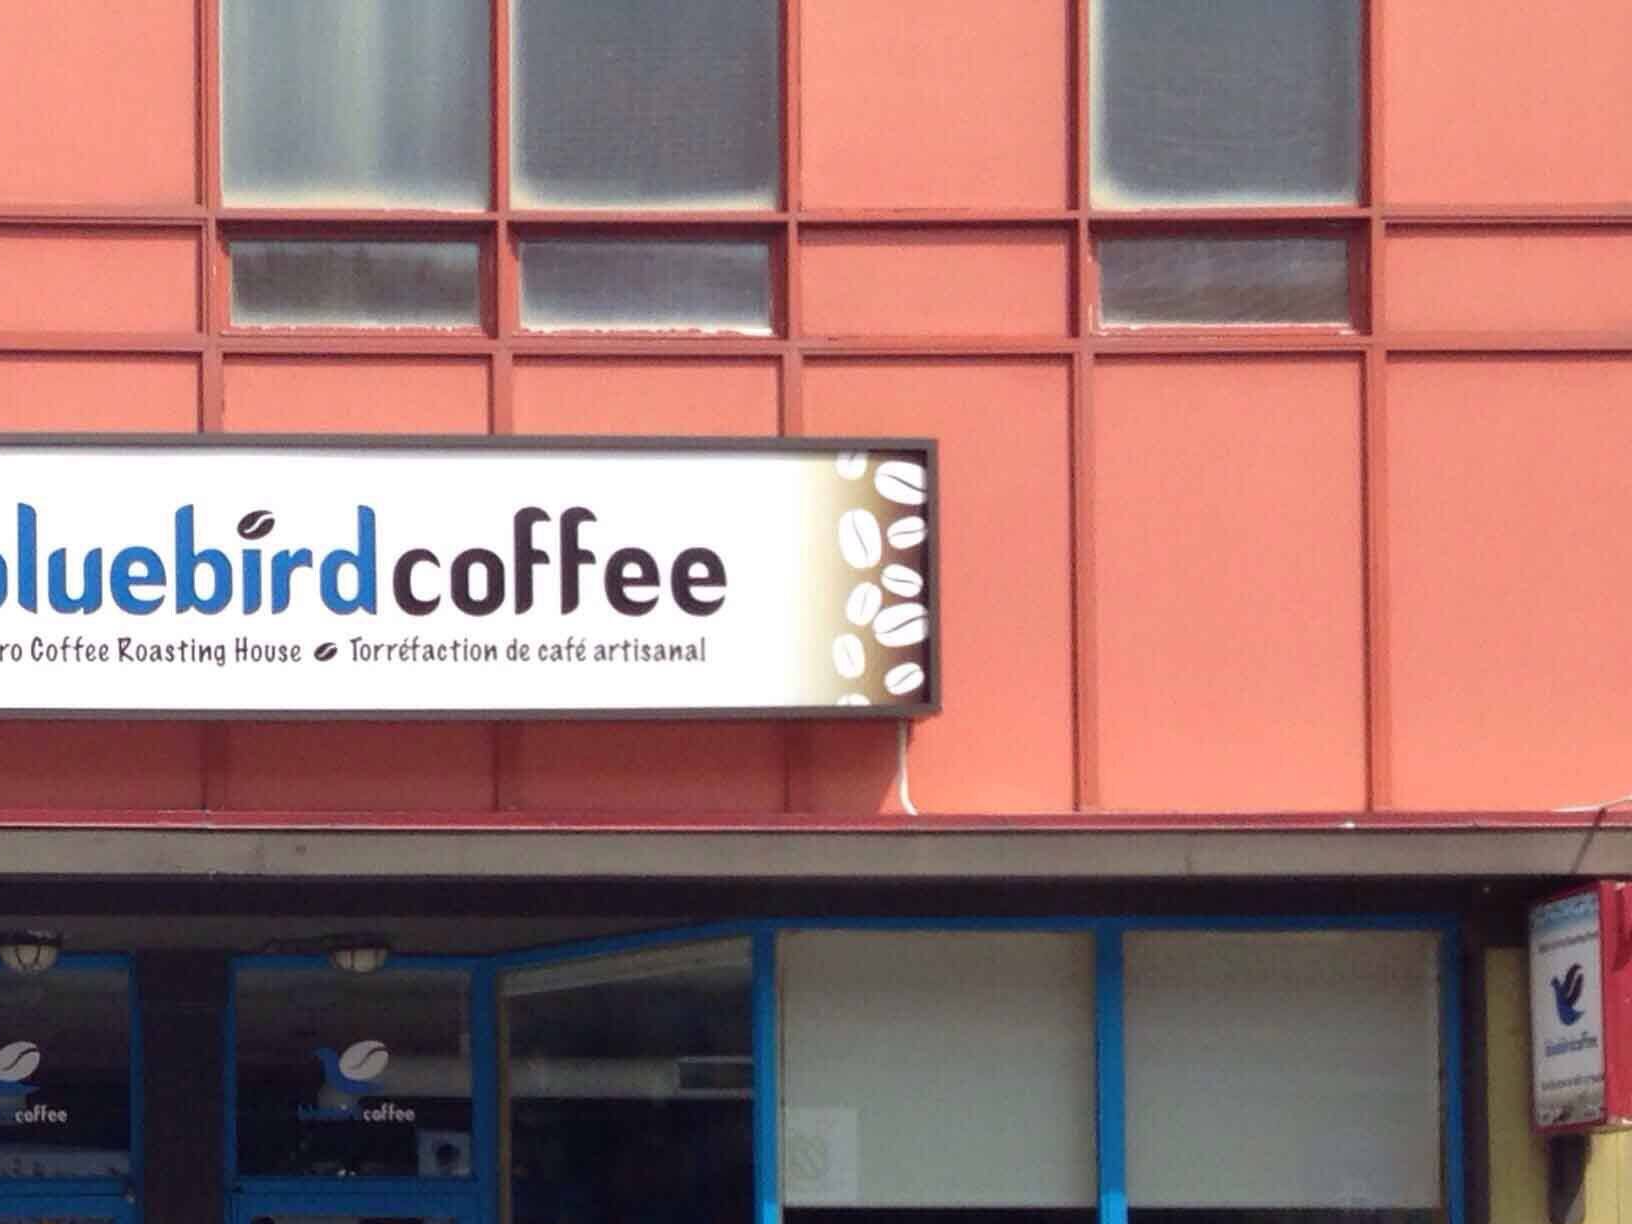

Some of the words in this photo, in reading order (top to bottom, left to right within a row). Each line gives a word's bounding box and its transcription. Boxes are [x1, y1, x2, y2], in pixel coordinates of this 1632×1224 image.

[31, 637, 108, 661] Coffee
[118, 638, 225, 666] Roasting
[236, 638, 300, 662] House
[351, 637, 496, 662] Torréfaction
[507, 639, 528, 661] de
[539, 639, 584, 662] café
[595, 639, 704, 662] artisanal
